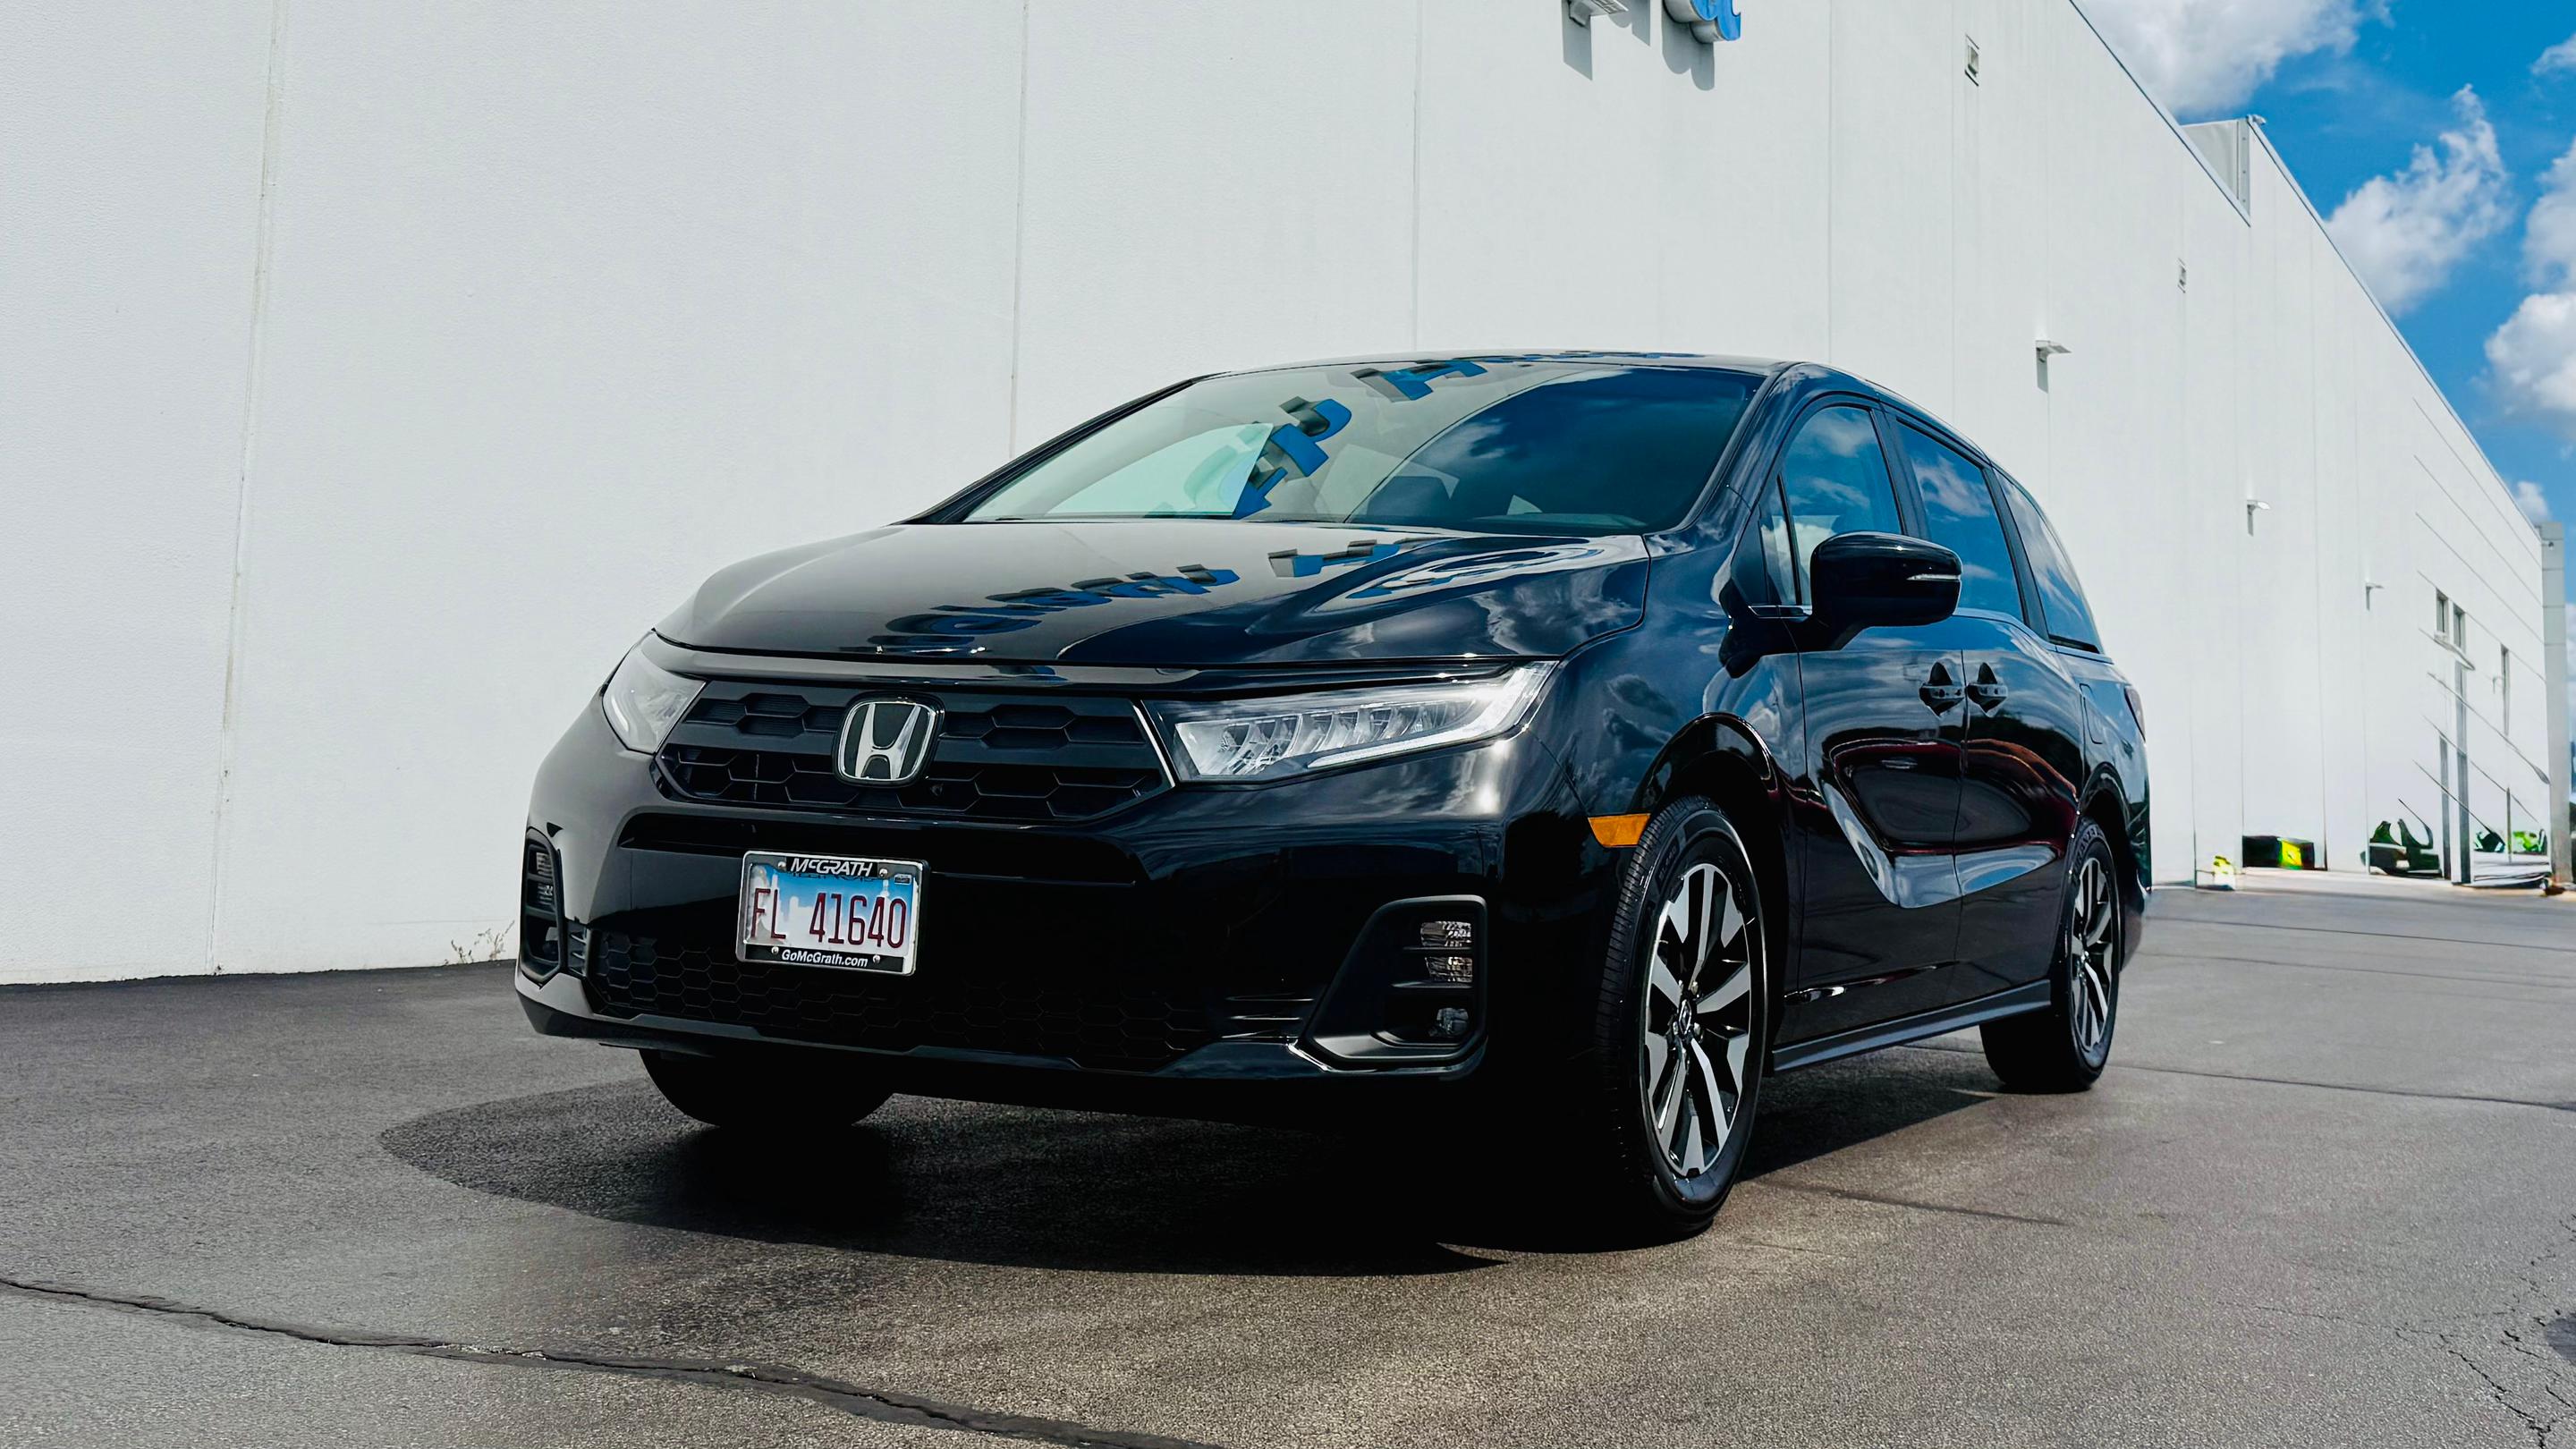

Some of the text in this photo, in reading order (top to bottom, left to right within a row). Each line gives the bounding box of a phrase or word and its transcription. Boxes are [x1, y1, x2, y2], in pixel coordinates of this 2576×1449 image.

[750, 887, 907, 949] FL 41640
[781, 949, 869, 968] GoMcGrath.com
